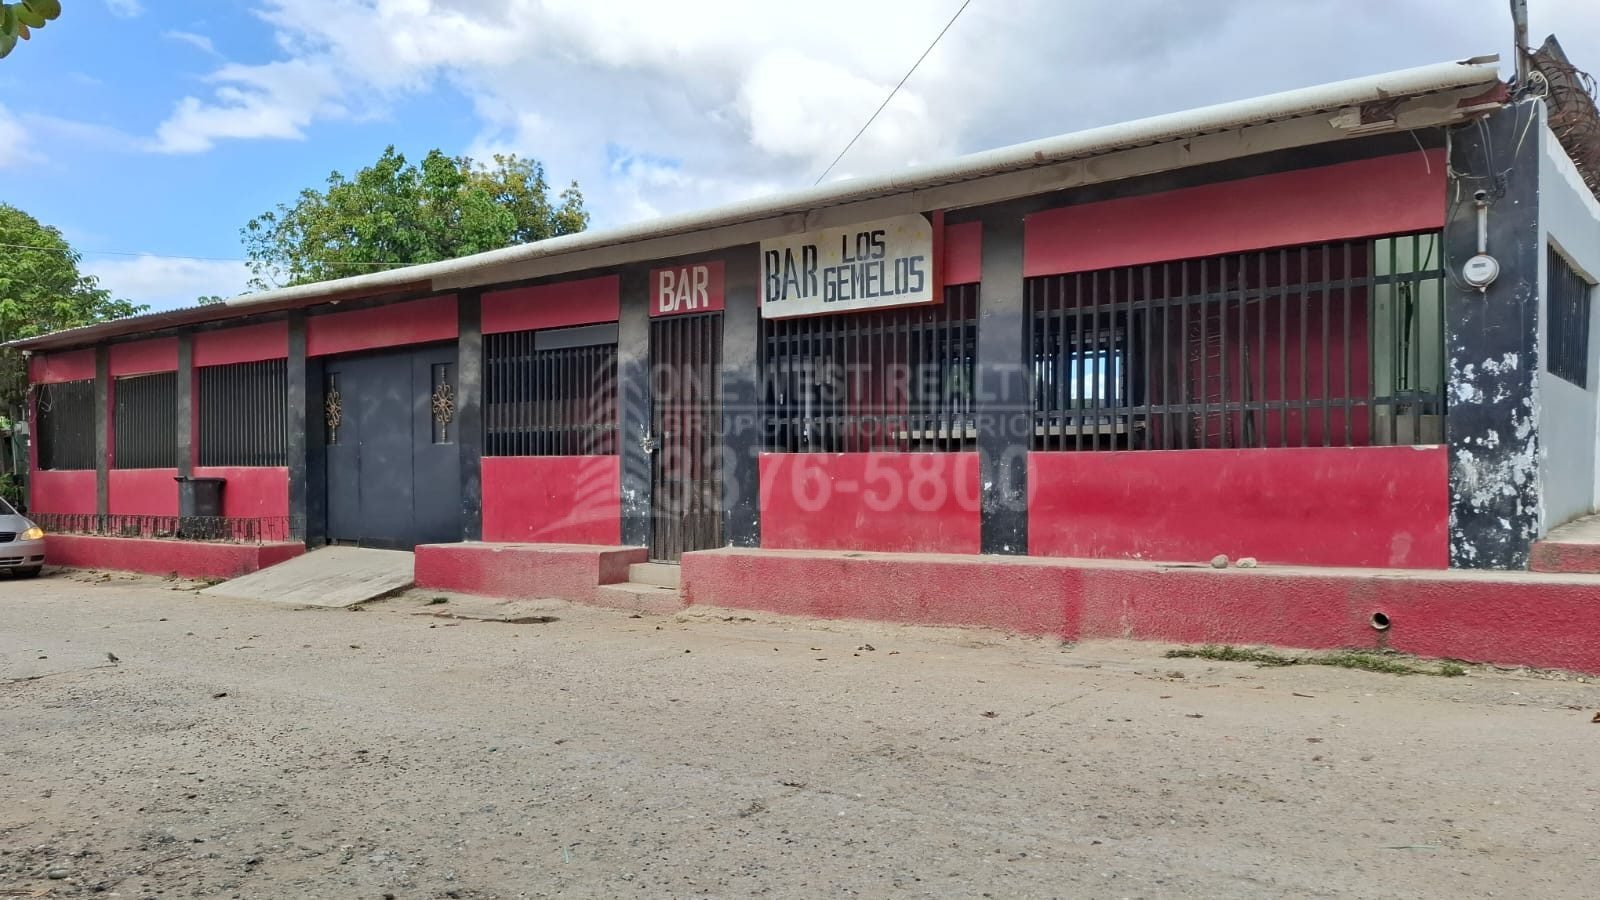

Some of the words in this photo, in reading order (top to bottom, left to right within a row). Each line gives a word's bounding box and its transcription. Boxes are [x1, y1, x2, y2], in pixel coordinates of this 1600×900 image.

[842, 230, 886, 263] LOS
[659, 265, 709, 312] BAR
[765, 244, 818, 303] BAR
[823, 255, 924, 303] GEMELOS
